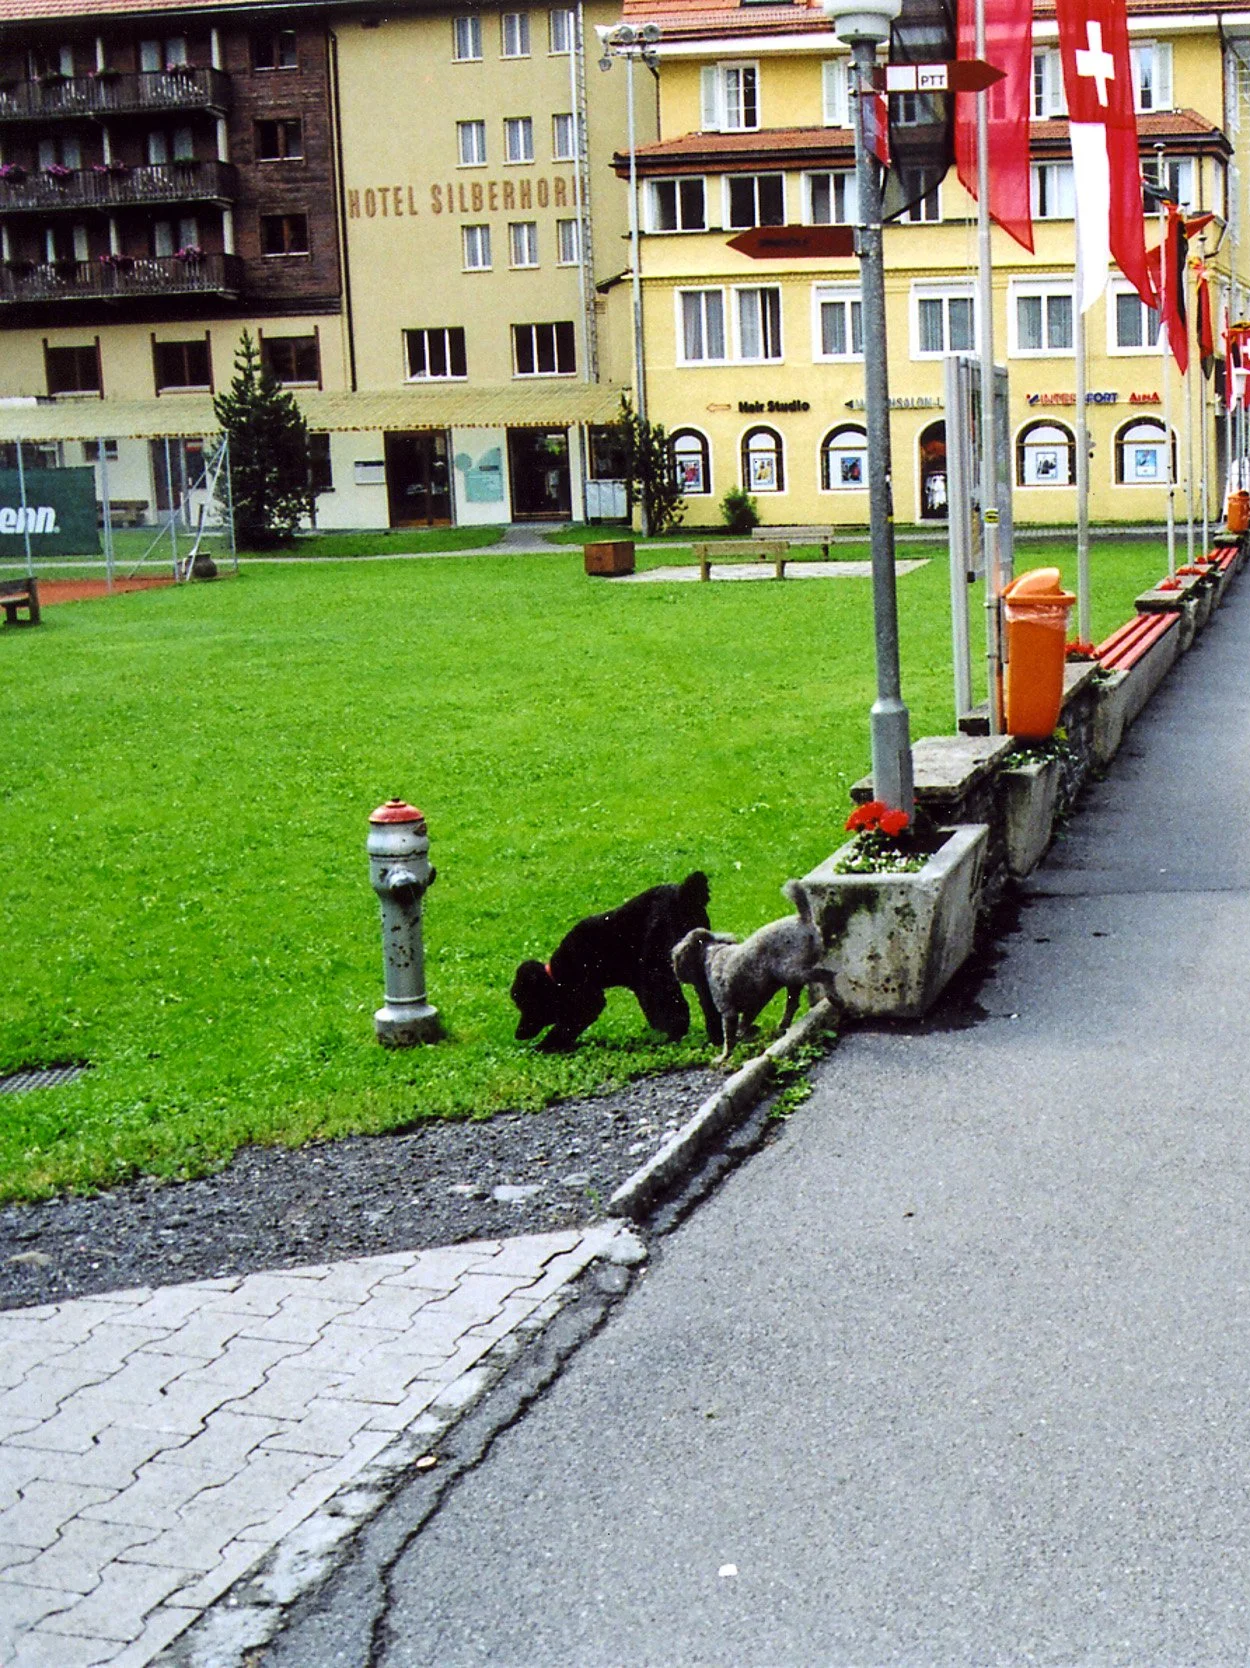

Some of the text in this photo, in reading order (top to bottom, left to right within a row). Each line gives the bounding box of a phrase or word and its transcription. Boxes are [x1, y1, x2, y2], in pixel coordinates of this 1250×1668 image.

[920, 75, 945, 87] PTT
[348, 184, 418, 219] HOTEL
[1040, 392, 1118, 405] INTERPORT
[738, 399, 810, 413] Hair Studio
